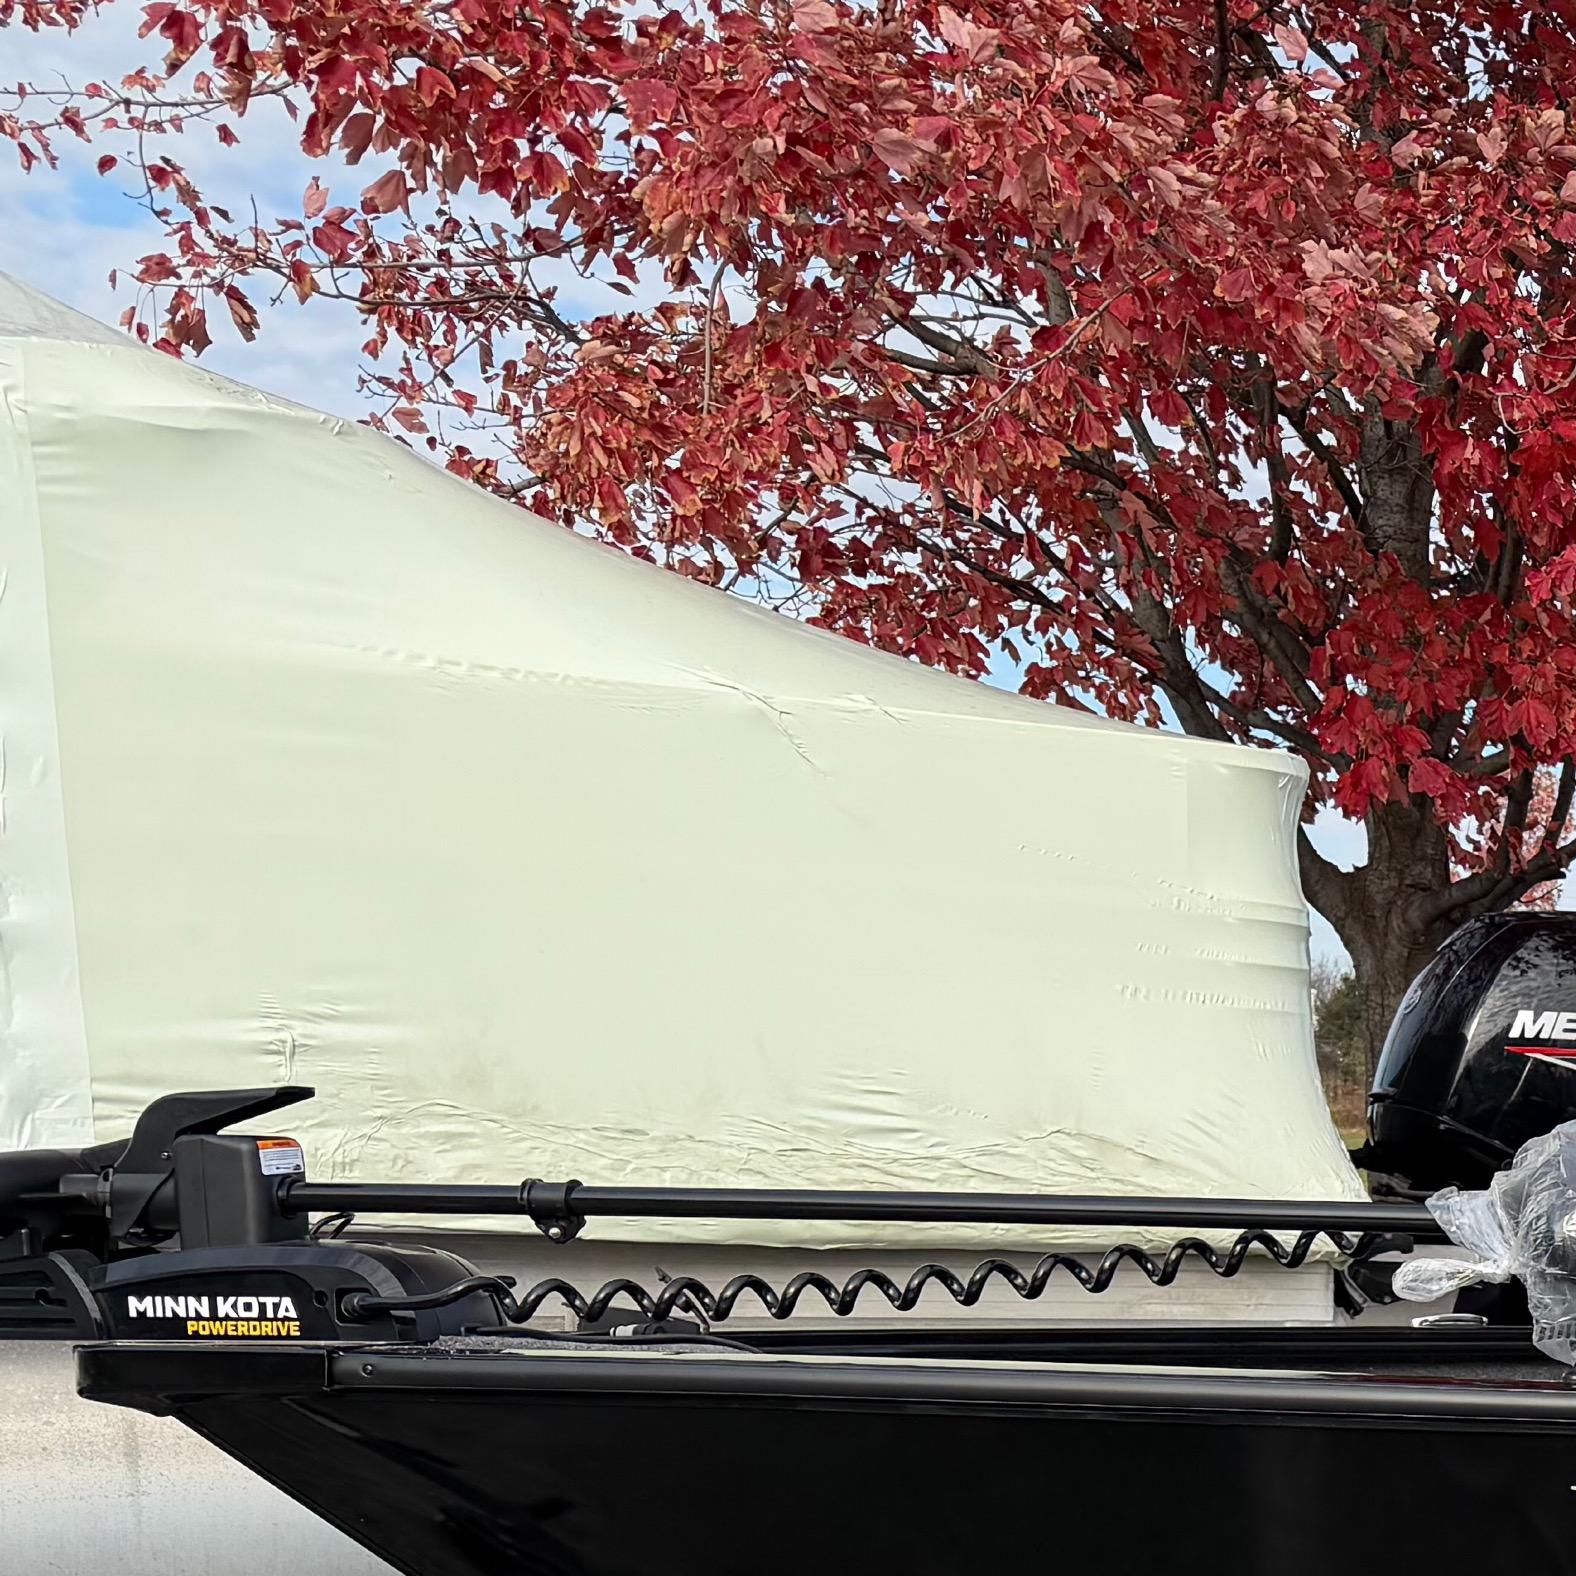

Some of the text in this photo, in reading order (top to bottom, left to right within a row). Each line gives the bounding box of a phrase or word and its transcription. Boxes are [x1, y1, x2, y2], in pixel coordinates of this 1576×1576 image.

[127, 1296, 298, 1318] MINN KOTA
[187, 1320, 300, 1336] POWERDRIVE
